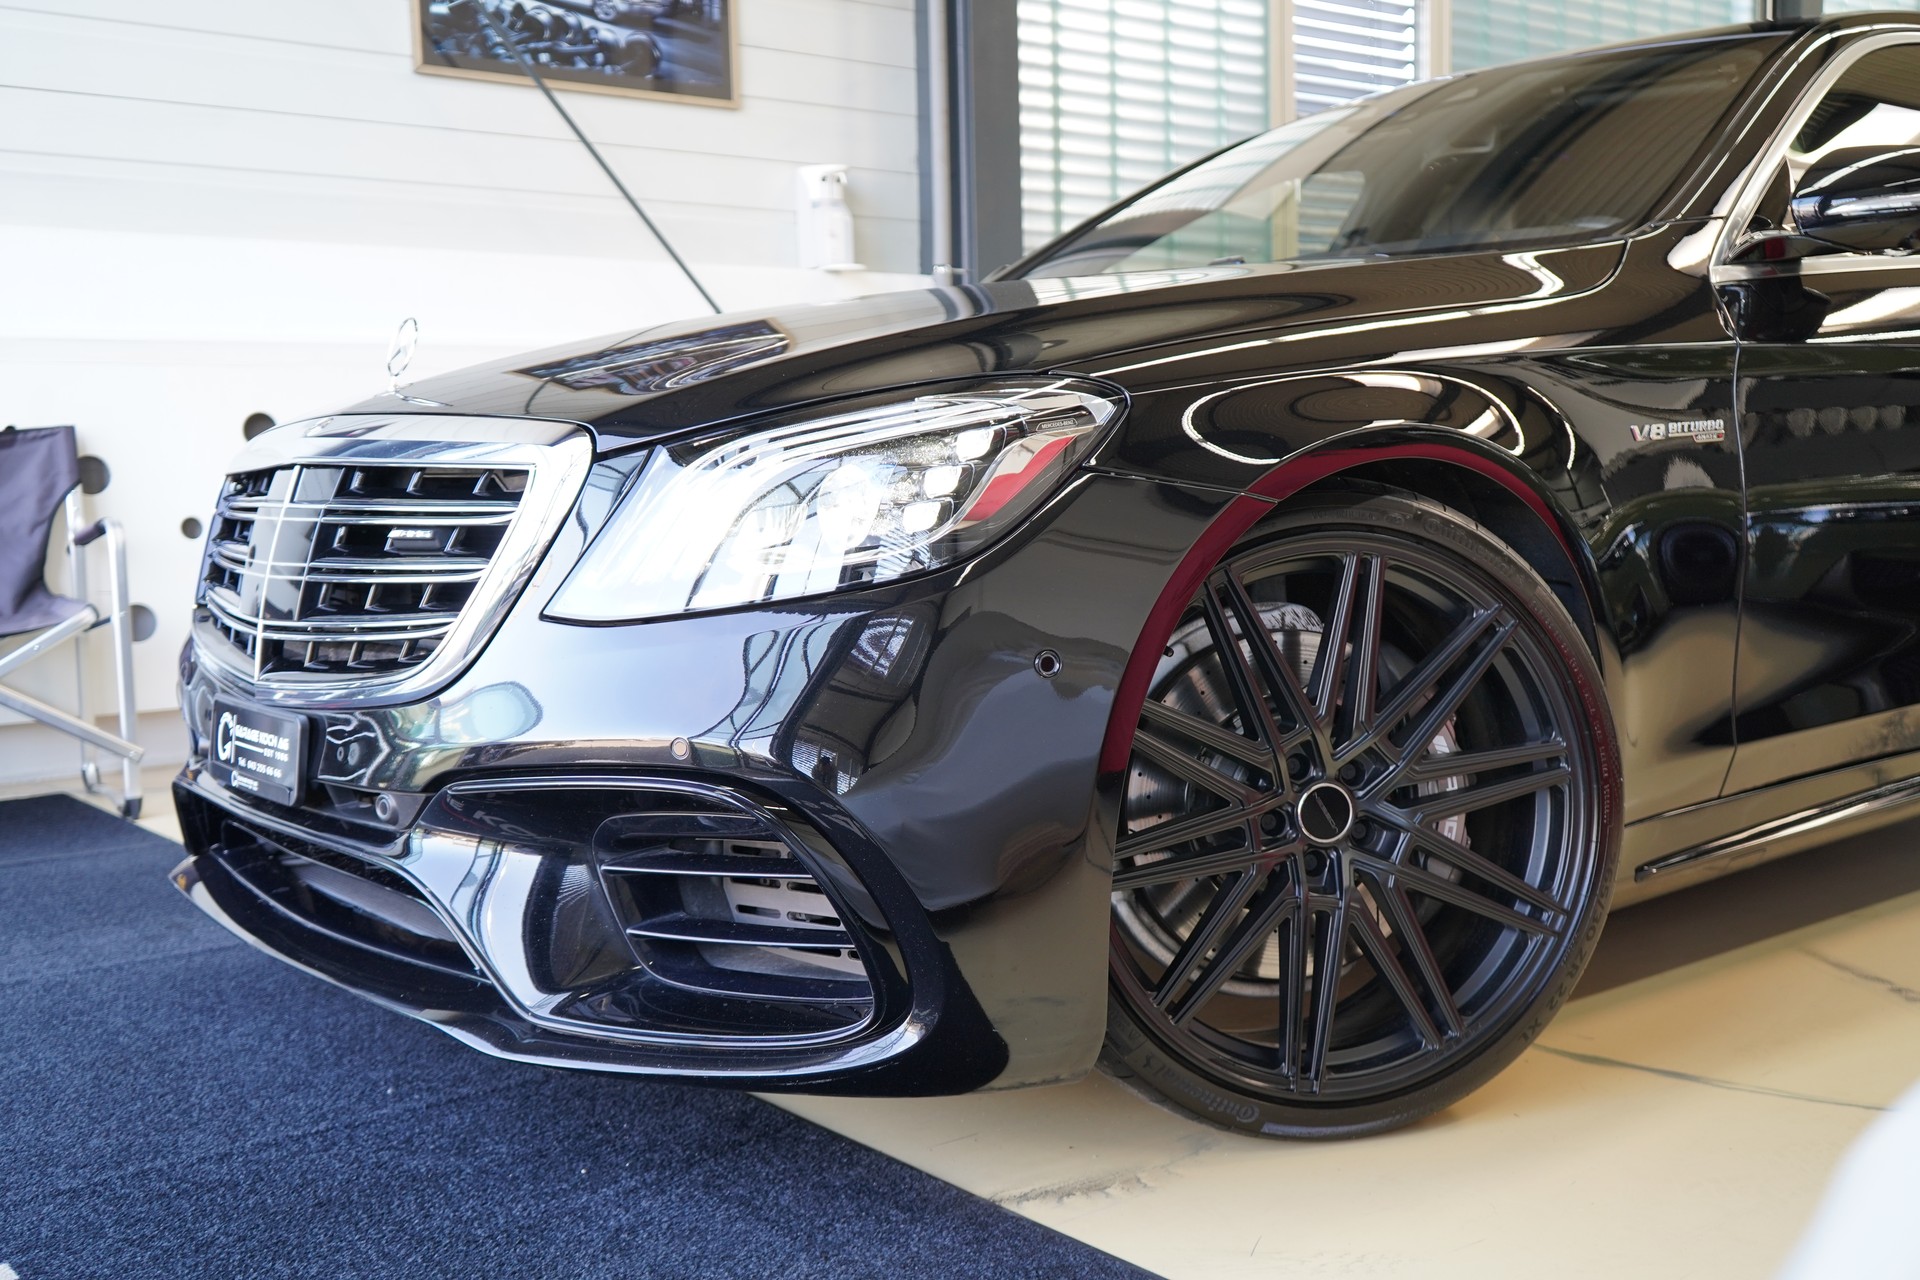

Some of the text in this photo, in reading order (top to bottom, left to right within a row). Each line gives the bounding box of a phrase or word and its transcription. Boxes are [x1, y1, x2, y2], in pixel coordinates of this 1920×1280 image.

[1041, 419, 1074, 429] MERCEDES-BENZ
[1630, 419, 1724, 442] V8 BITURBO
